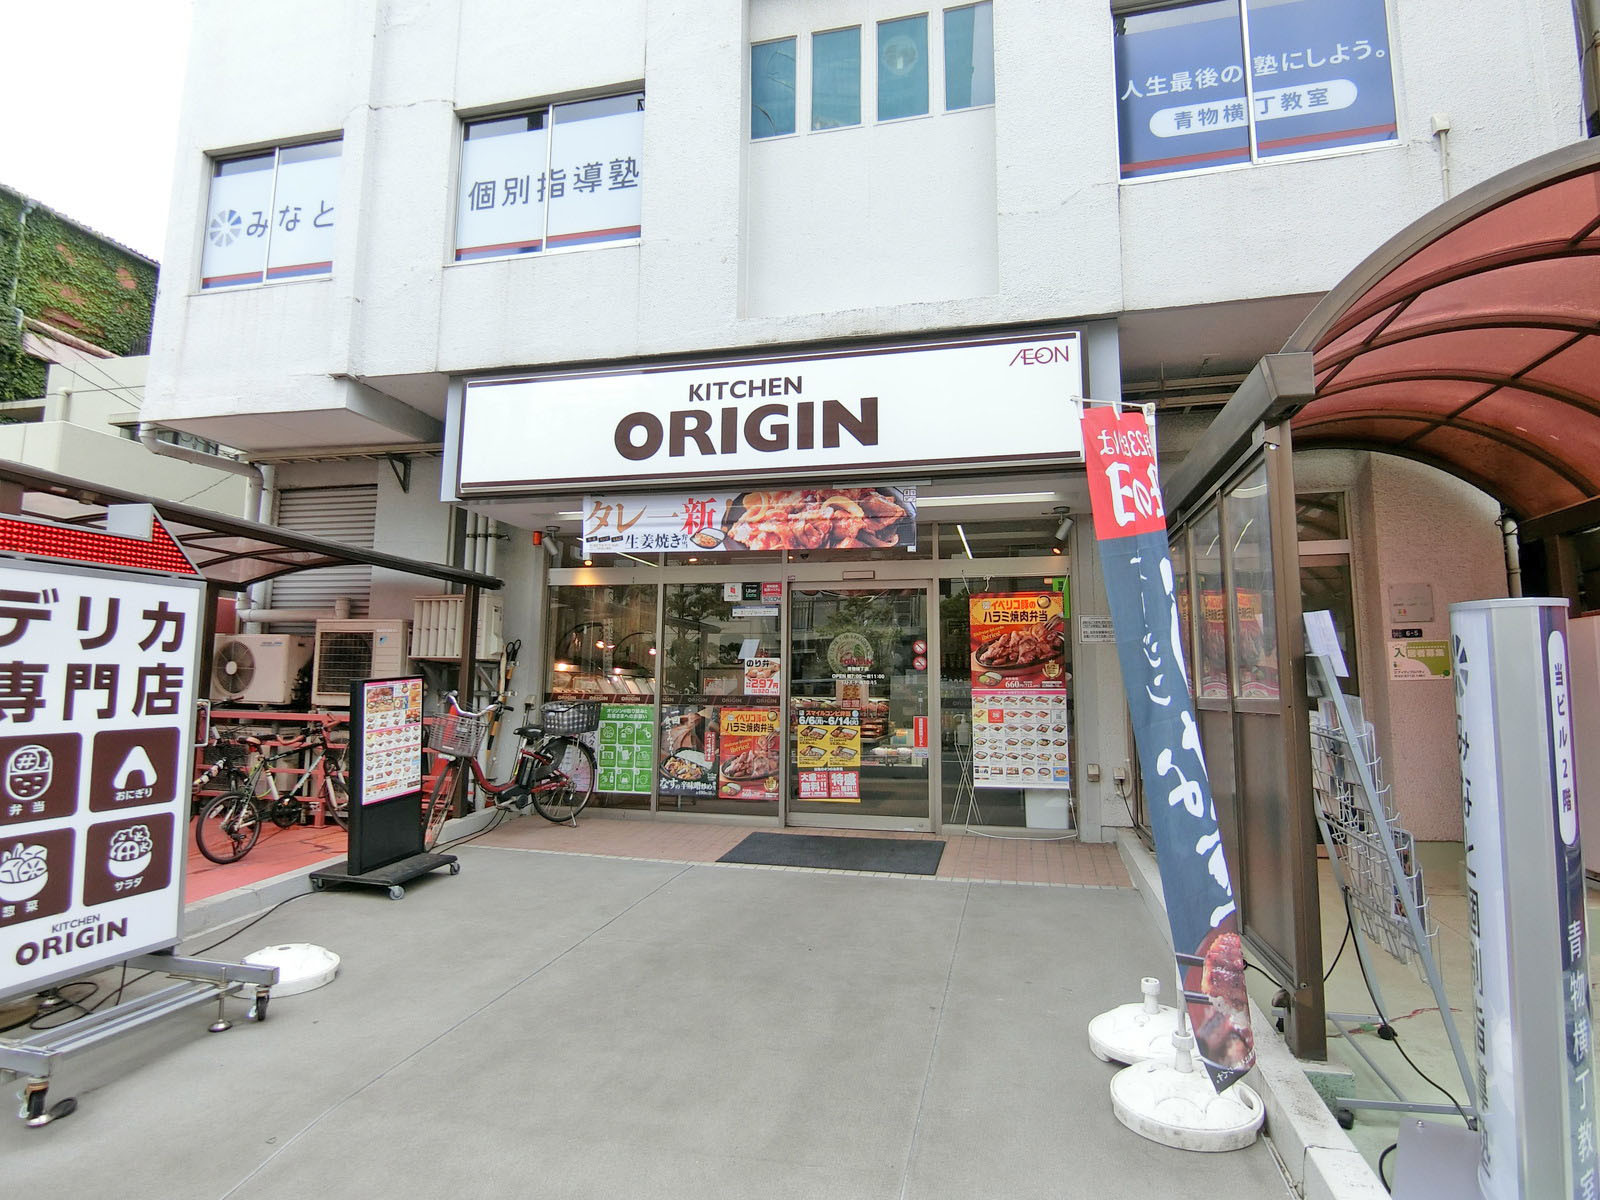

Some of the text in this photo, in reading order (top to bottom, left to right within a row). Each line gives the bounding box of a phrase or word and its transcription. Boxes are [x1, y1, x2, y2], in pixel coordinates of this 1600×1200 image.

[1121, 40, 1385, 101] 人生最後の塾にしよう。
[1174, 88, 1329, 131] 青物横丁教室
[467, 156, 640, 211] 個別指導塾
[246, 200, 335, 238] みなと
[688, 376, 803, 402] KITCHEN
[614, 397, 878, 461] ORIGIN
[0, 588, 186, 653] デリカ
[983, 611, 1048, 623] ハラミ焼肉弁当
[746, 659, 770, 667] のり弁
[0, 660, 185, 723] 専門店
[1554, 662, 1573, 813] 当ビル2階
[8, 801, 46, 816] 弁当
[115, 787, 153, 801] おにぎり
[114, 876, 144, 892] サラダ
[15, 917, 128, 966] ORIGIN
[51, 913, 101, 934] KITCHEN
